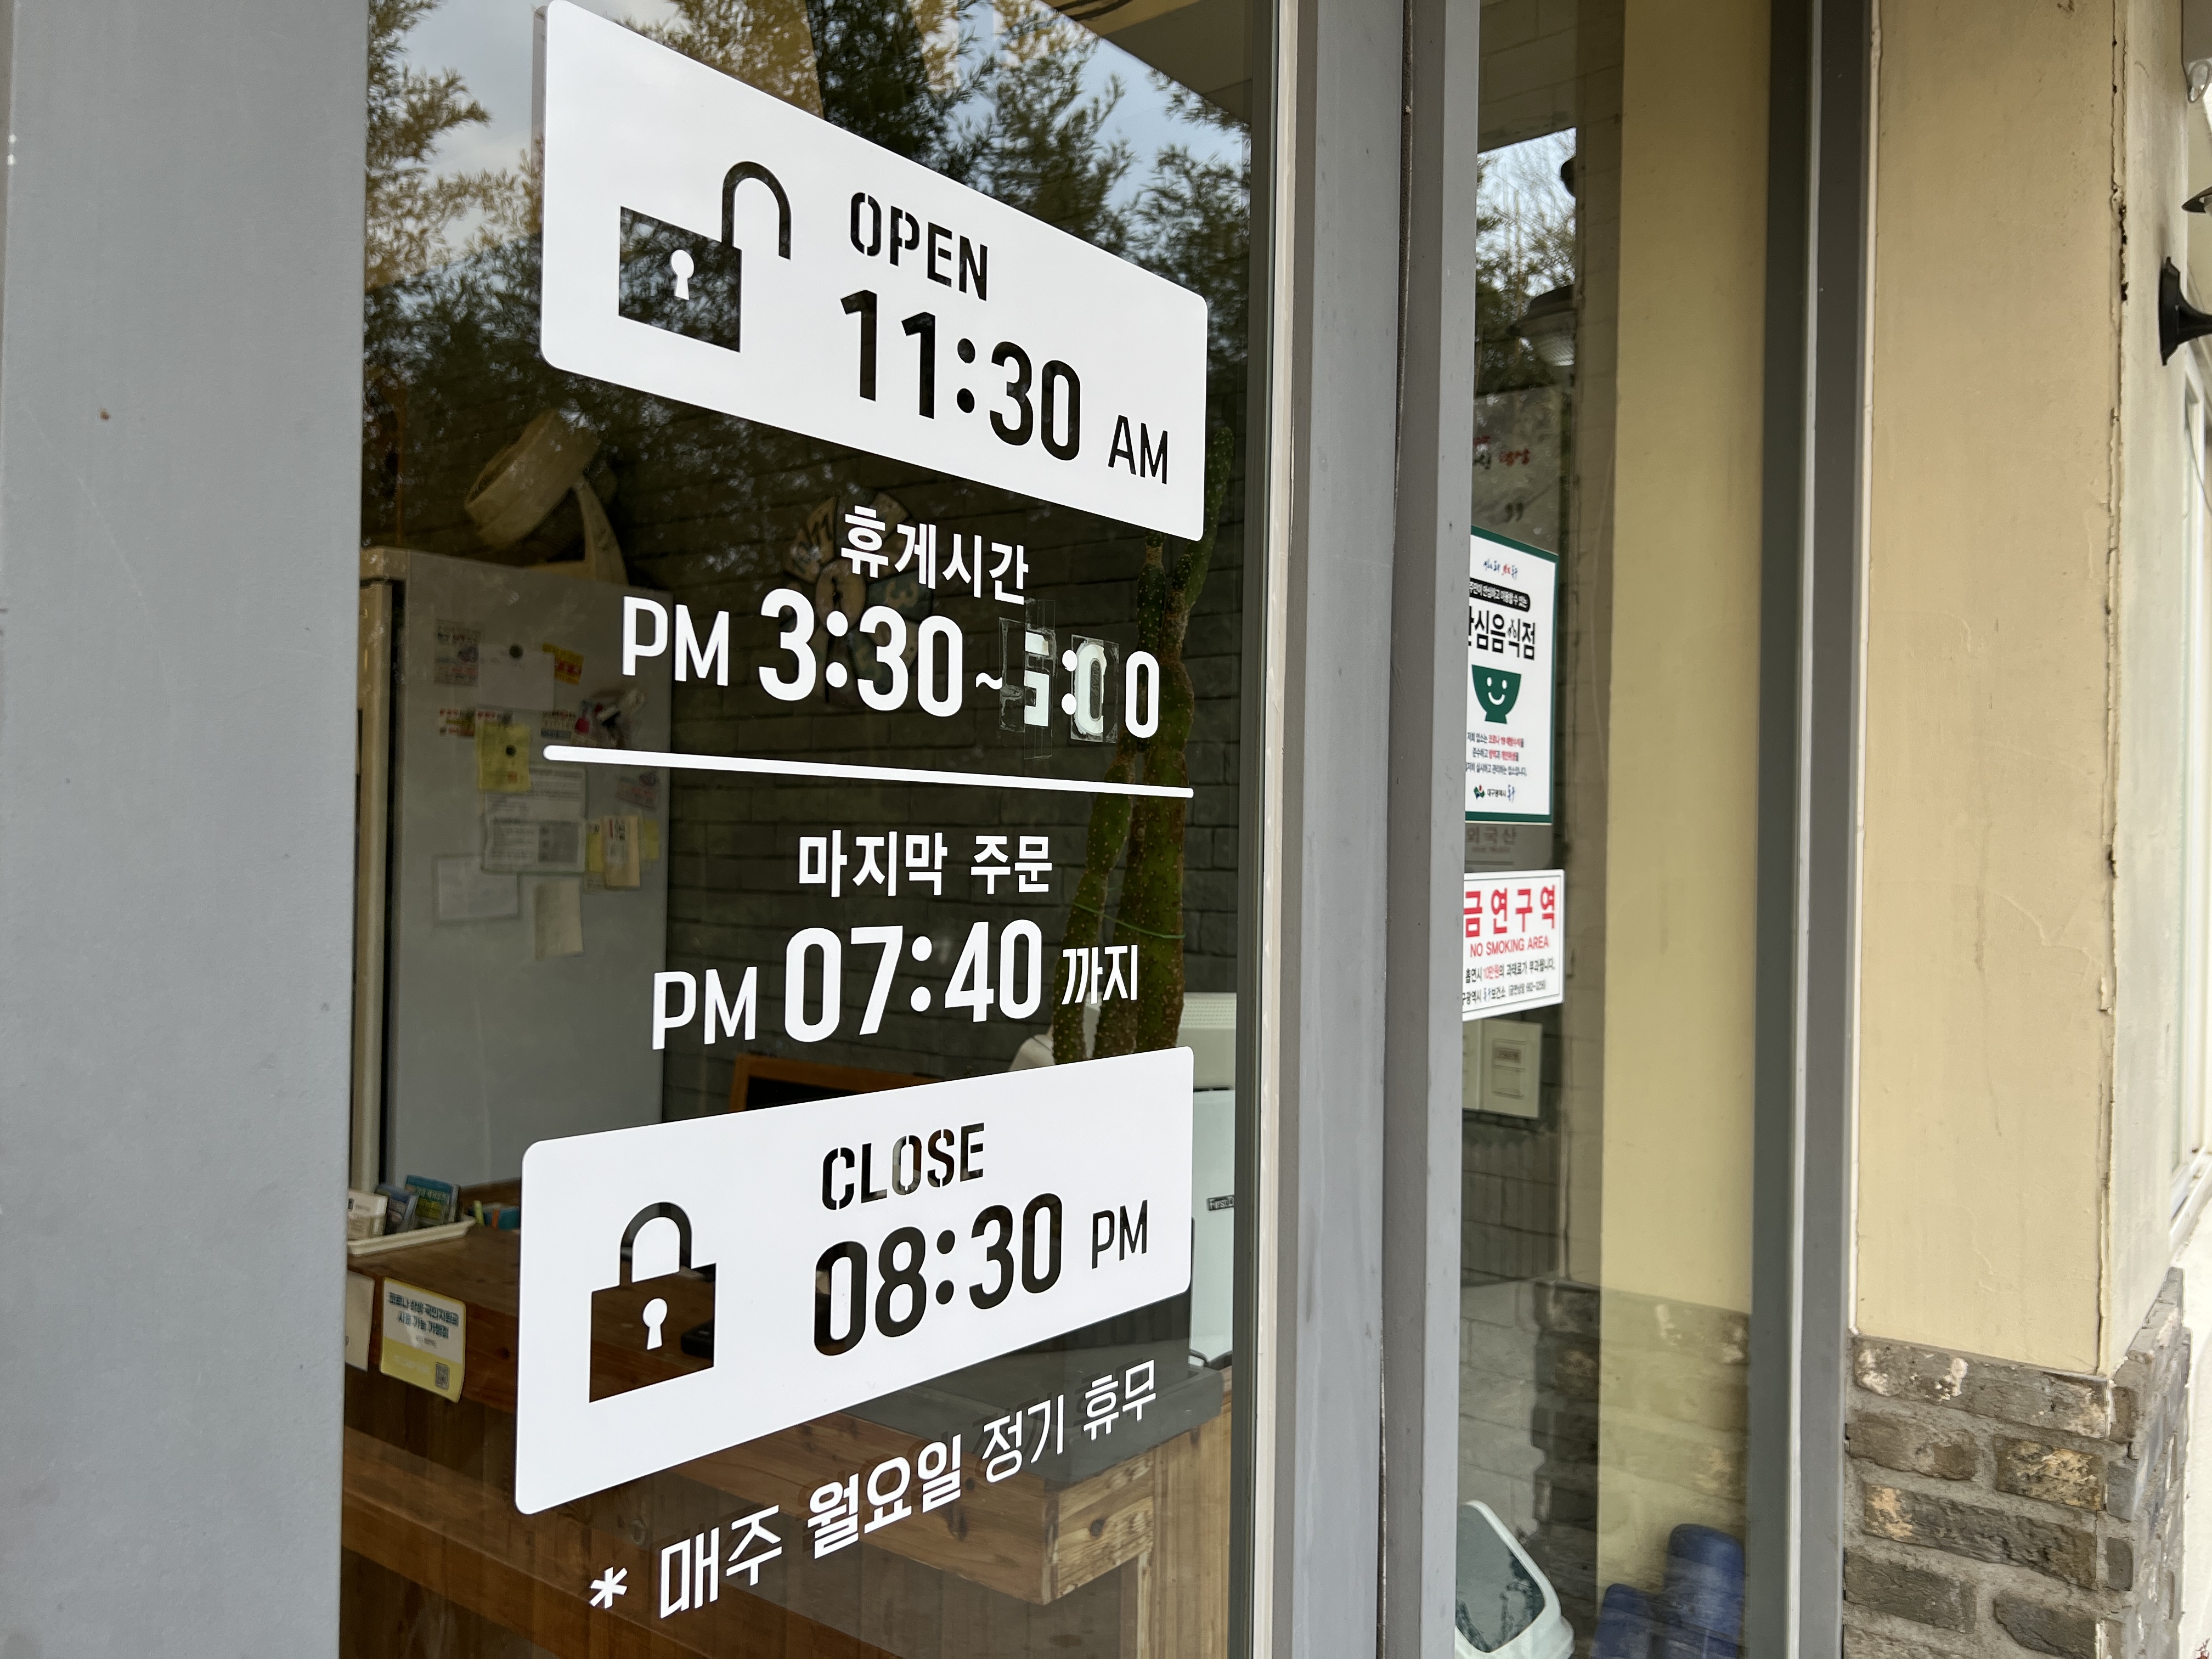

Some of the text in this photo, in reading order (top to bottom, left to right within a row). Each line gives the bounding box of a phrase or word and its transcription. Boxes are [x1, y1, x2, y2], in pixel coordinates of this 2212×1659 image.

[849, 192, 988, 301] OPEN
[840, 289, 1168, 485] 11:30 AM
[841, 505, 1029, 605] 휴게시간
[623, 596, 729, 686] PM
[799, 830, 1052, 898] 마지막 주문
[1463, 884, 1556, 938] 금연구역
[652, 919, 1138, 1050] PM 07:40 까지
[1470, 935, 1549, 957] NO SMOKING AREA
[822, 1122, 985, 1211] CLOSE
[814, 1193, 1148, 1356] 08:30 PM
[660, 1359, 1156, 1619] 매주 월요일 정기 휴무
